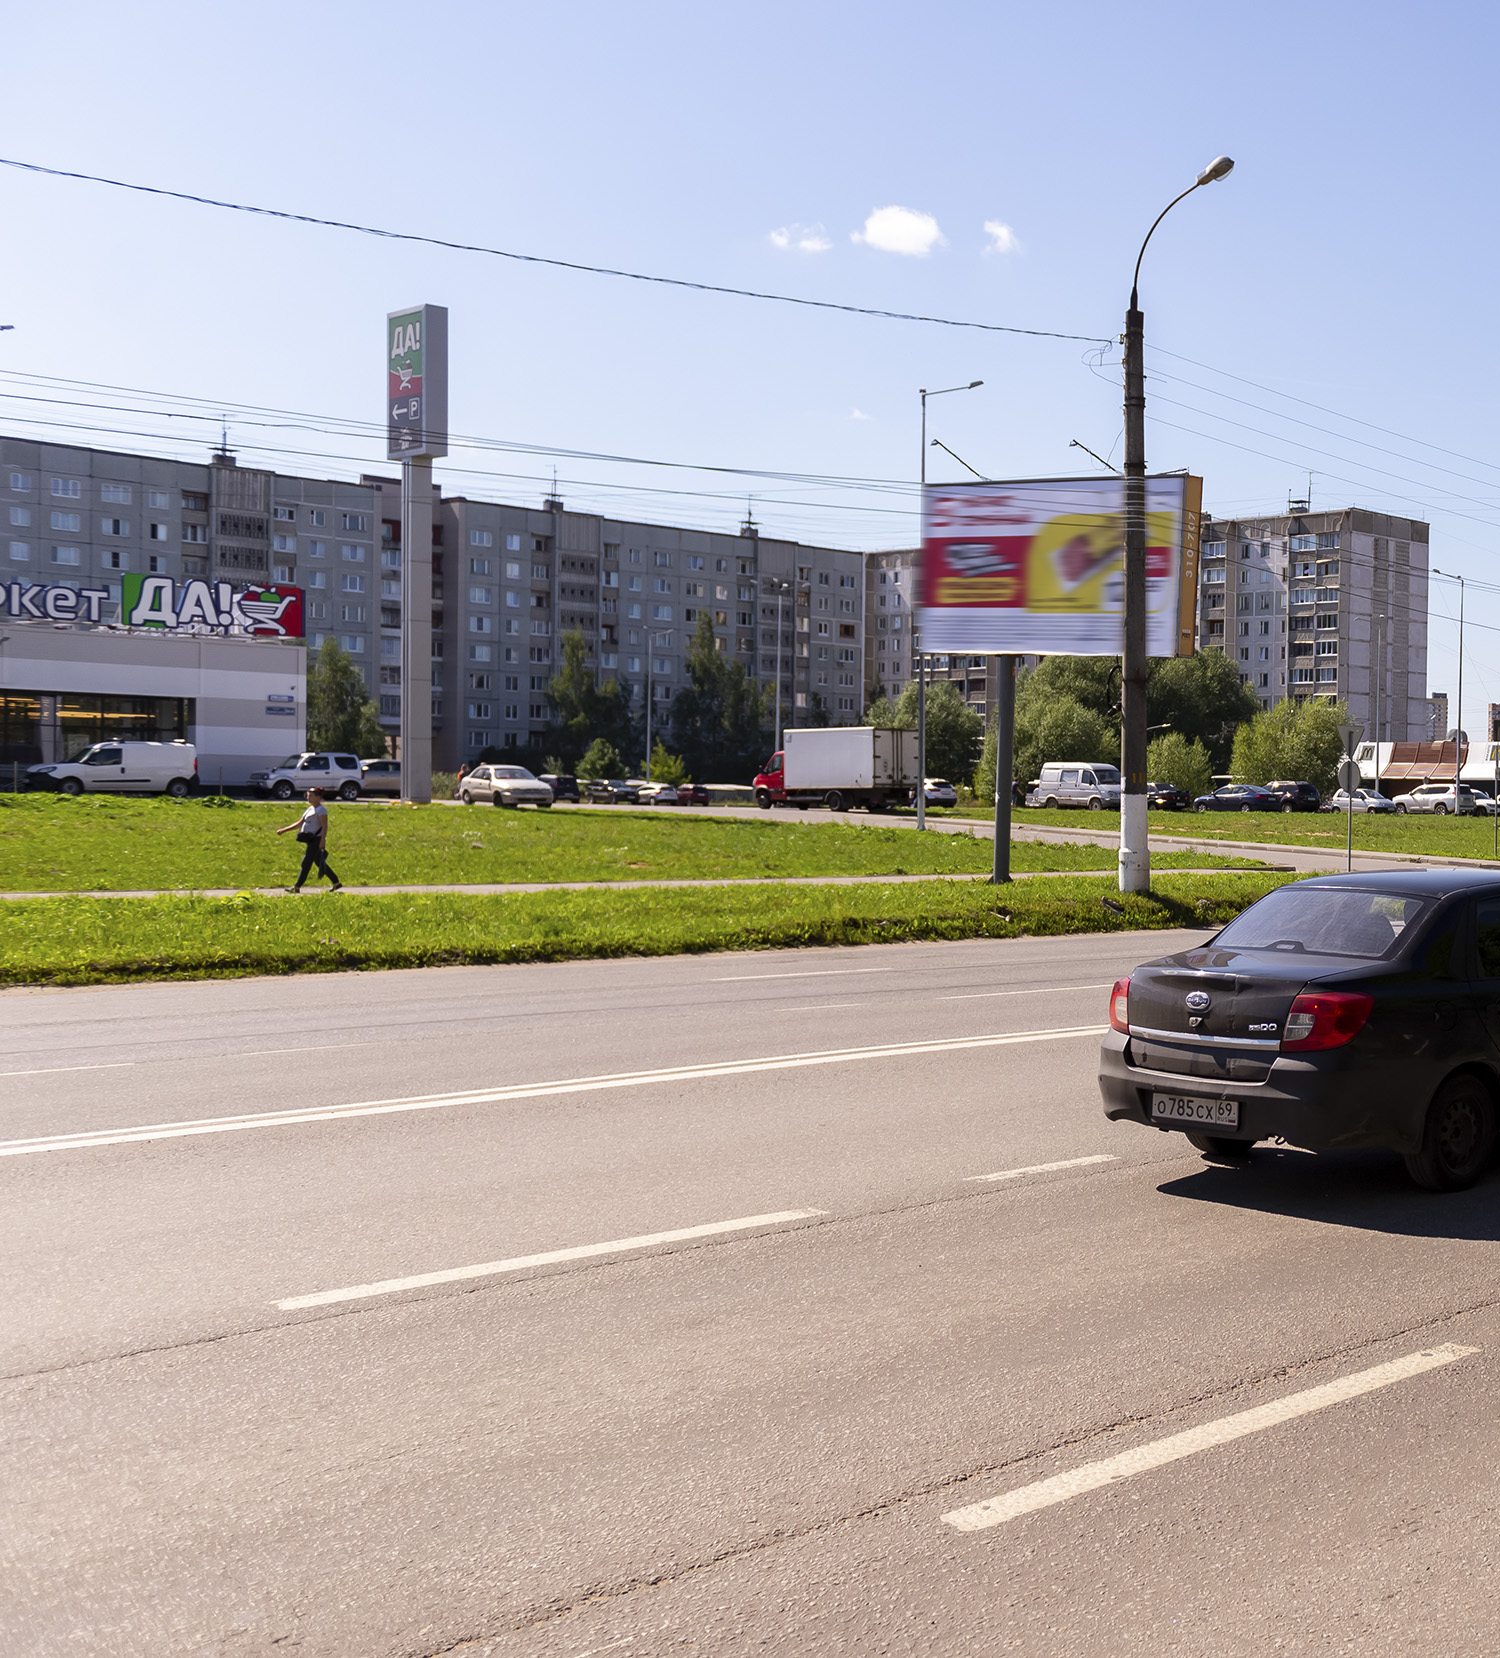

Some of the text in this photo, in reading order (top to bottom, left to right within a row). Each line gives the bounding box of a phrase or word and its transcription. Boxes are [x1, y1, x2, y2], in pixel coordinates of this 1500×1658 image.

[391, 322, 421, 360] ДА!
[1185, 511, 1197, 579] 310-707
[129, 576, 235, 628] ДА!
[1157, 1097, 1233, 1120] О785СХ 69
